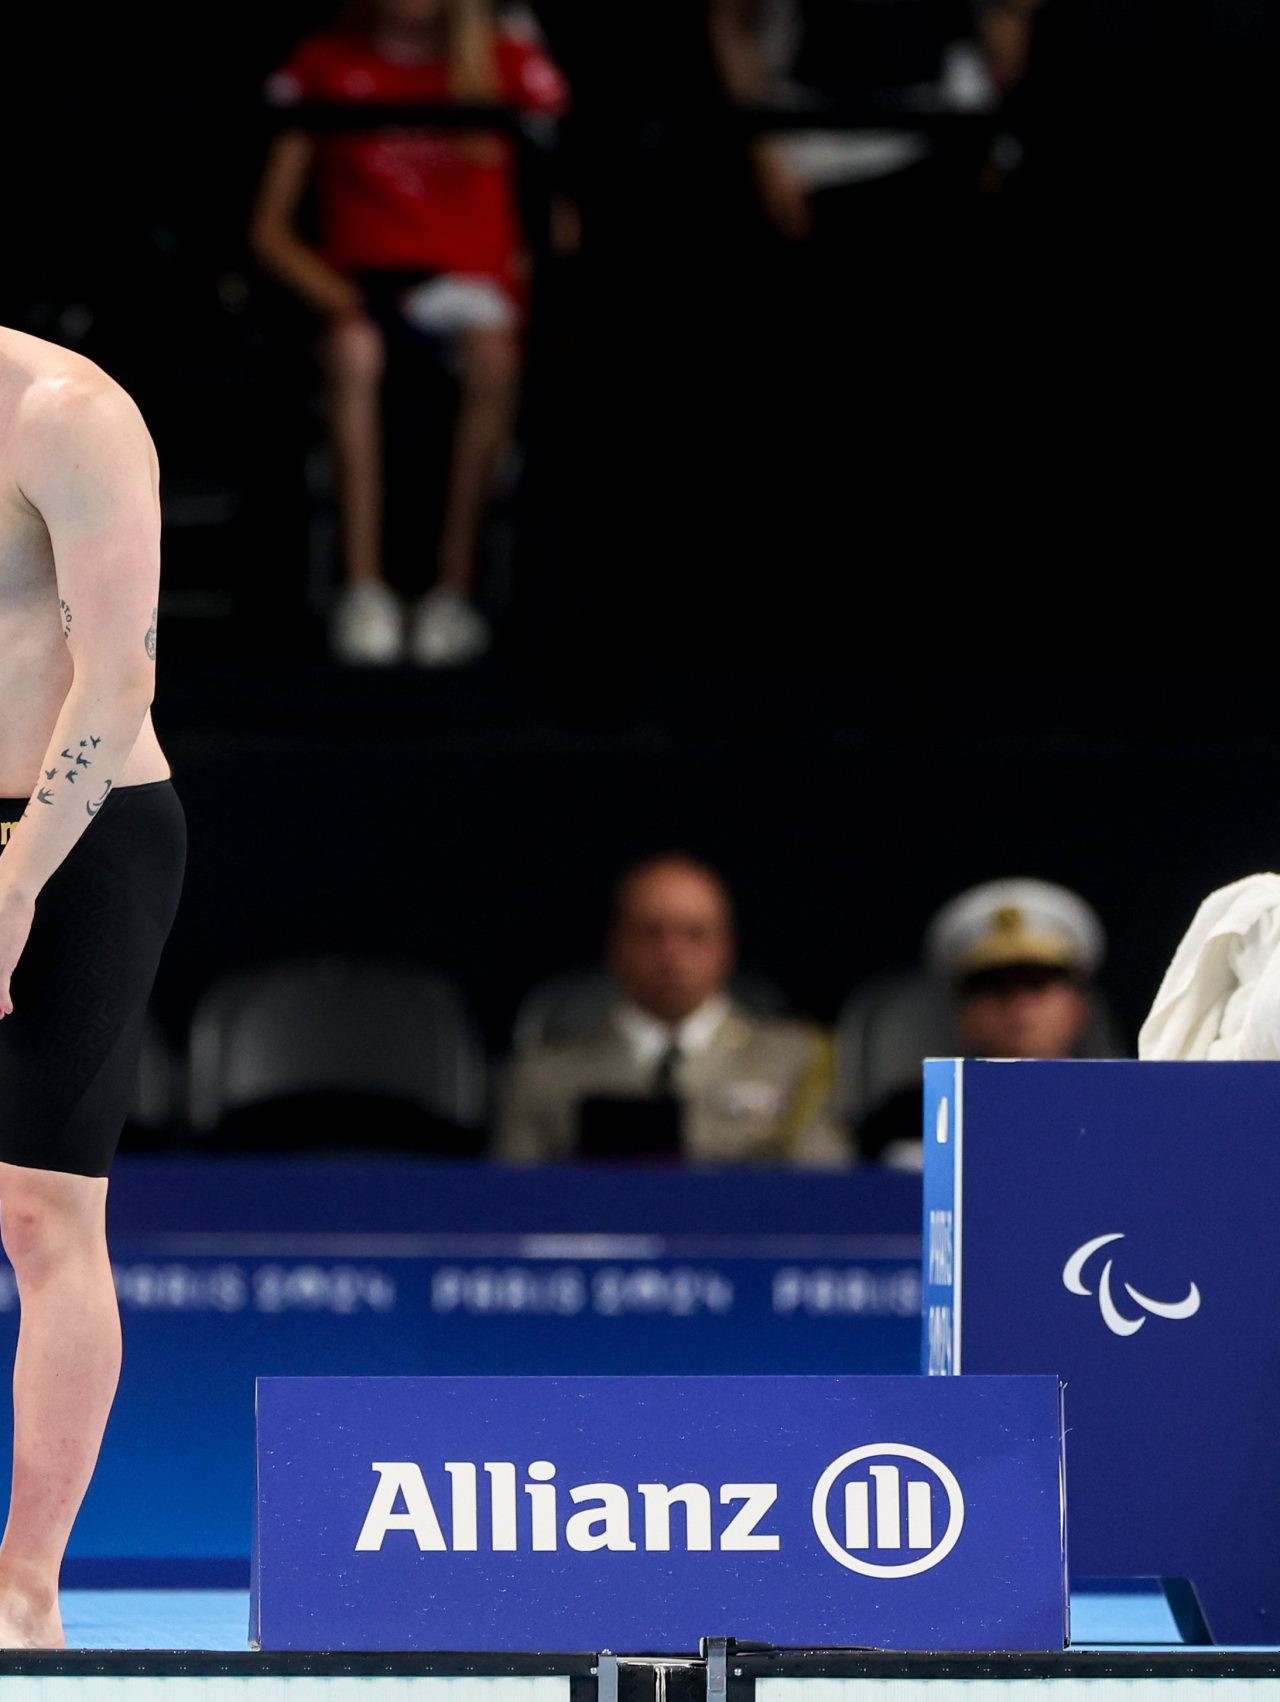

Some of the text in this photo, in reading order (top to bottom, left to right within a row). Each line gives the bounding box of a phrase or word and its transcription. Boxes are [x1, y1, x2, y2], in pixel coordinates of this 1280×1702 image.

[431, 1265, 734, 1316] PARIS 2024
[354, 1460, 780, 1552] Allianz
